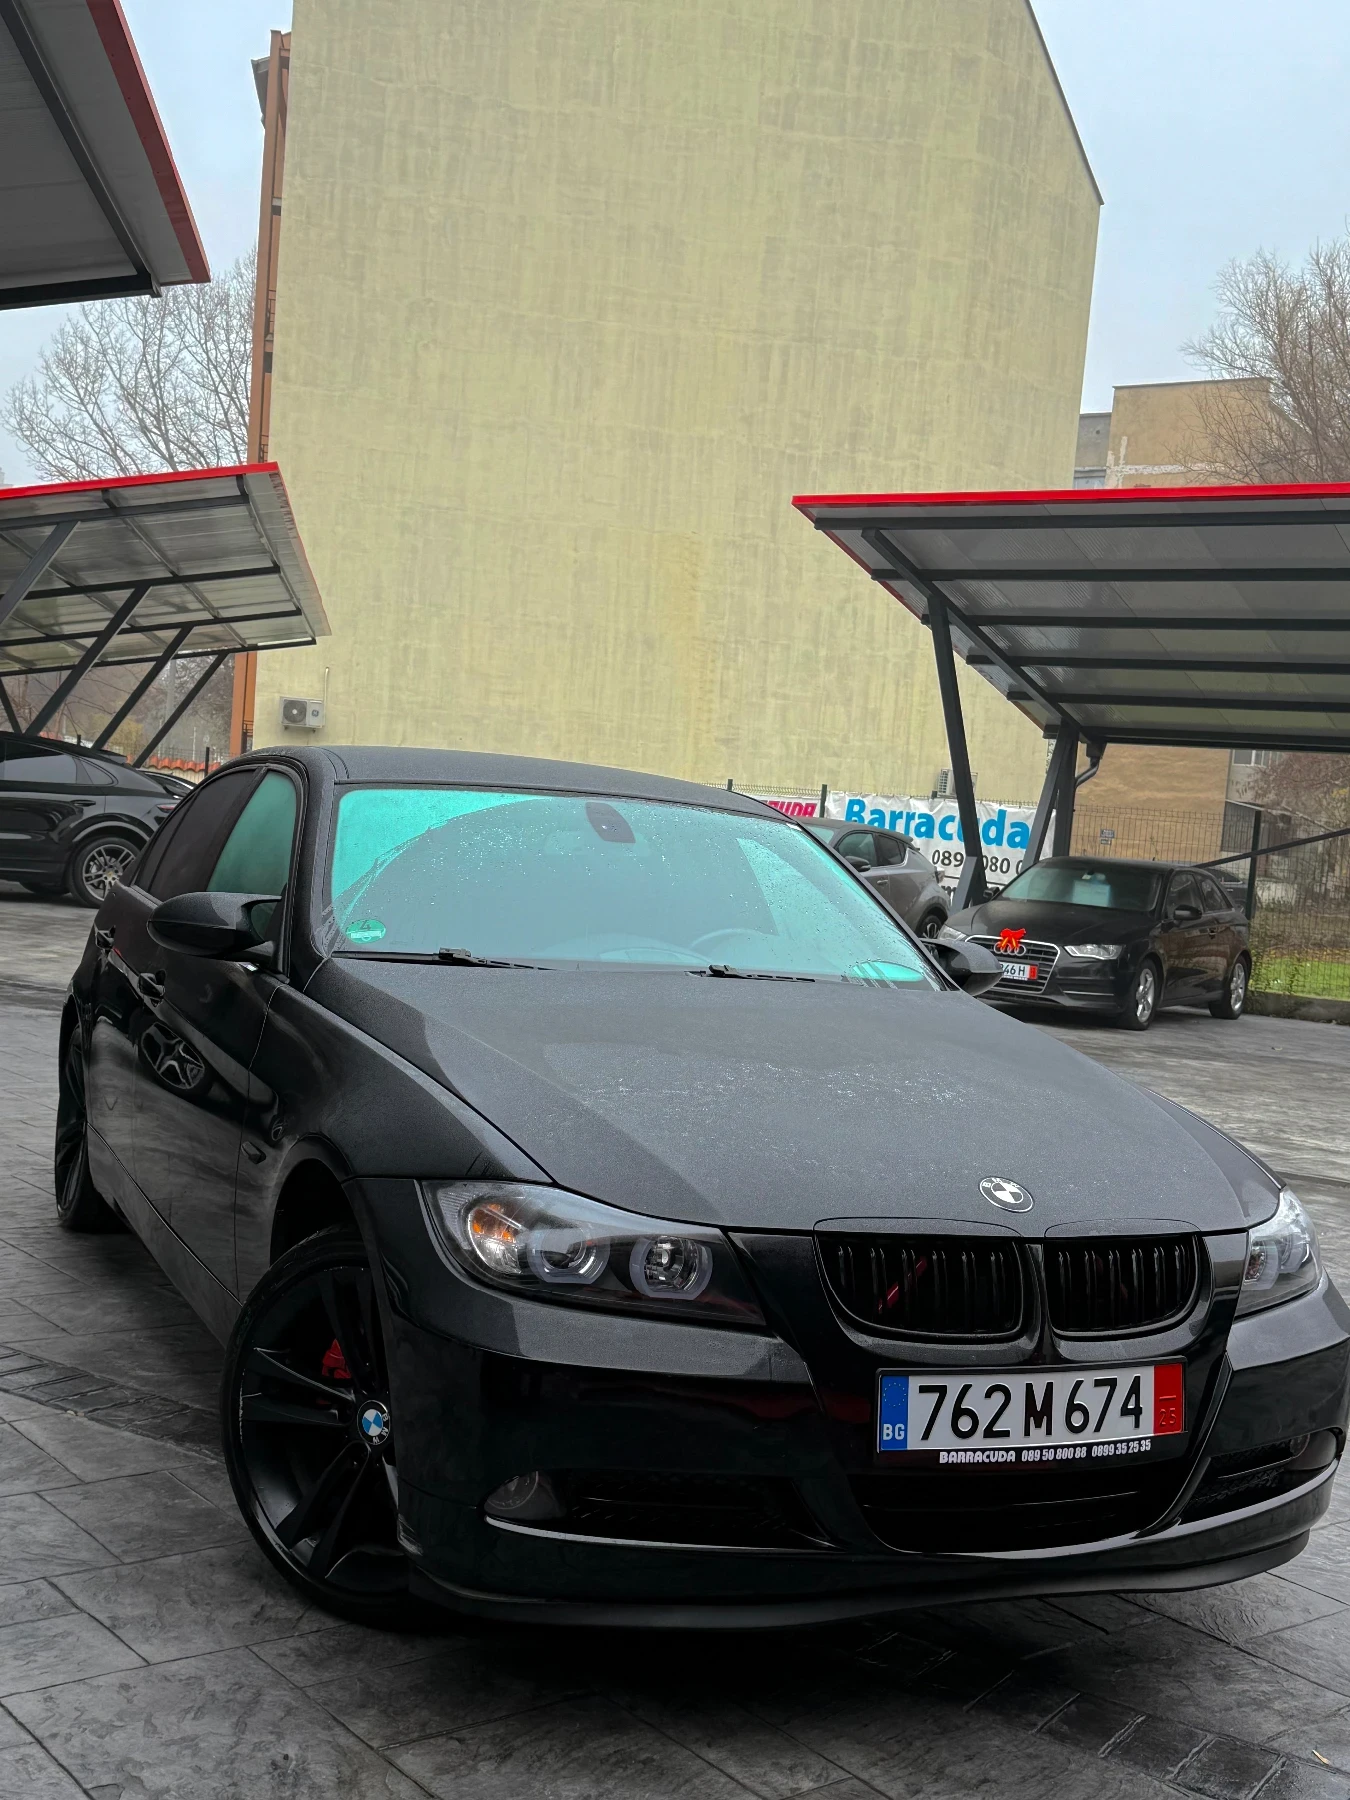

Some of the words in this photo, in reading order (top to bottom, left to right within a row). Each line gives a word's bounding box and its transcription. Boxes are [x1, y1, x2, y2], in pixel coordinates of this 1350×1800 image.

[1159, 1408, 1177, 1425] 25
[882, 1423, 905, 1440] BG
[939, 1450, 1016, 1463] BARRACUDA
